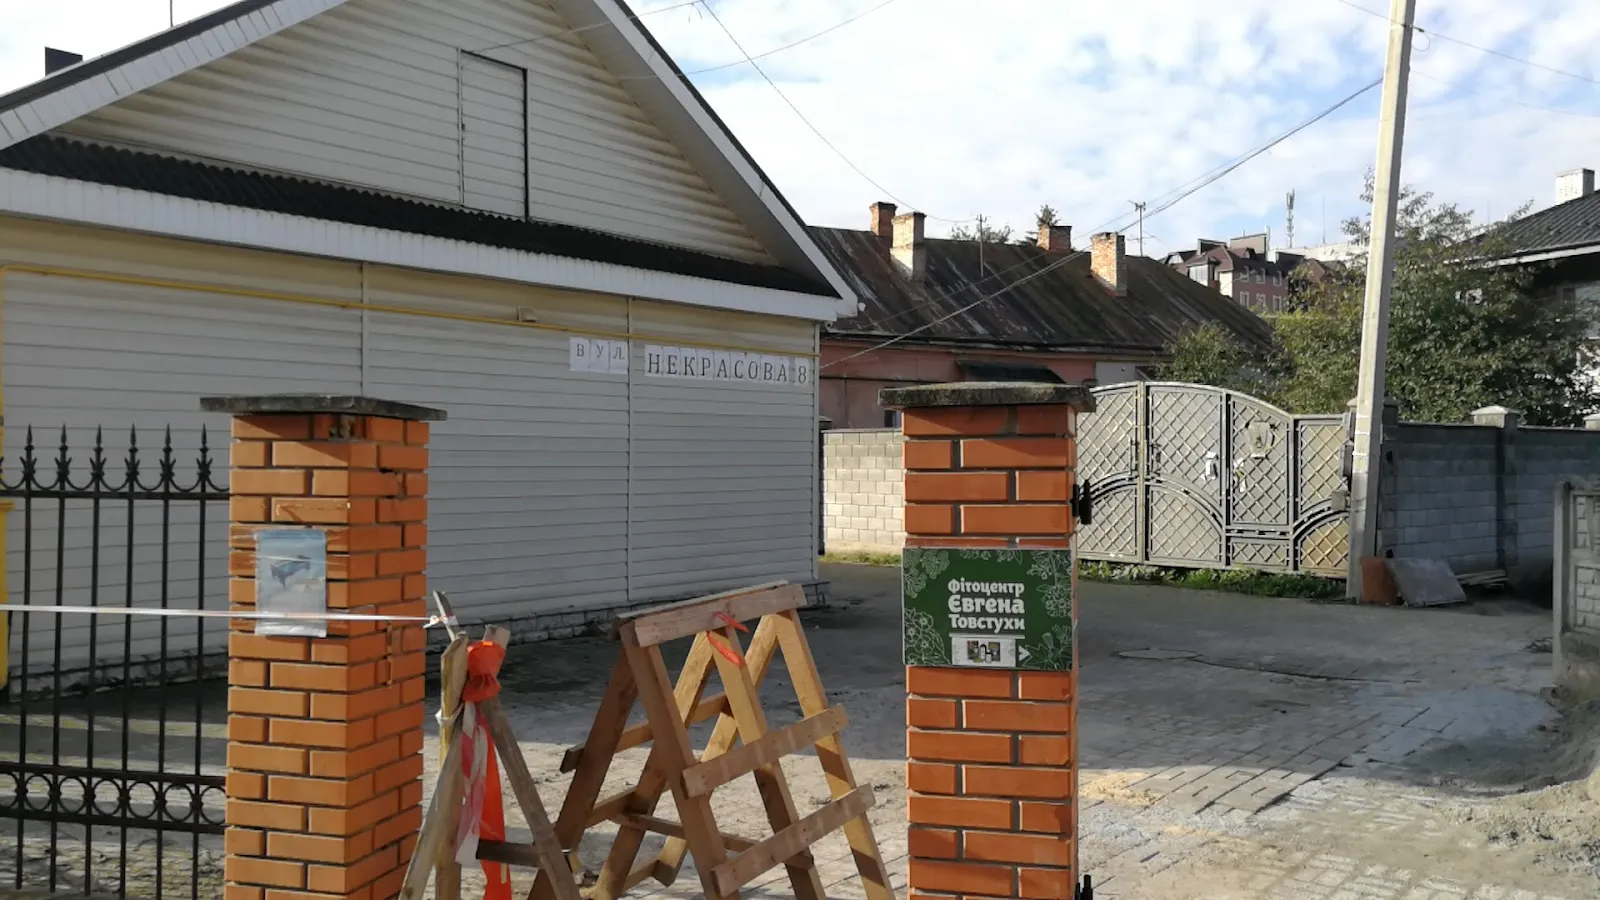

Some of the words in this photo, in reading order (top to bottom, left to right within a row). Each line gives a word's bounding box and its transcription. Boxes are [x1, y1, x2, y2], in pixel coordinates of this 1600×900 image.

[647, 353, 788, 382] НЕКРАСОВА
[798, 365, 808, 384] 8
[948, 577, 1024, 597] Фітоцентр
[948, 595, 1025, 614] Євгена
[948, 614, 1025, 633] Товстухи
